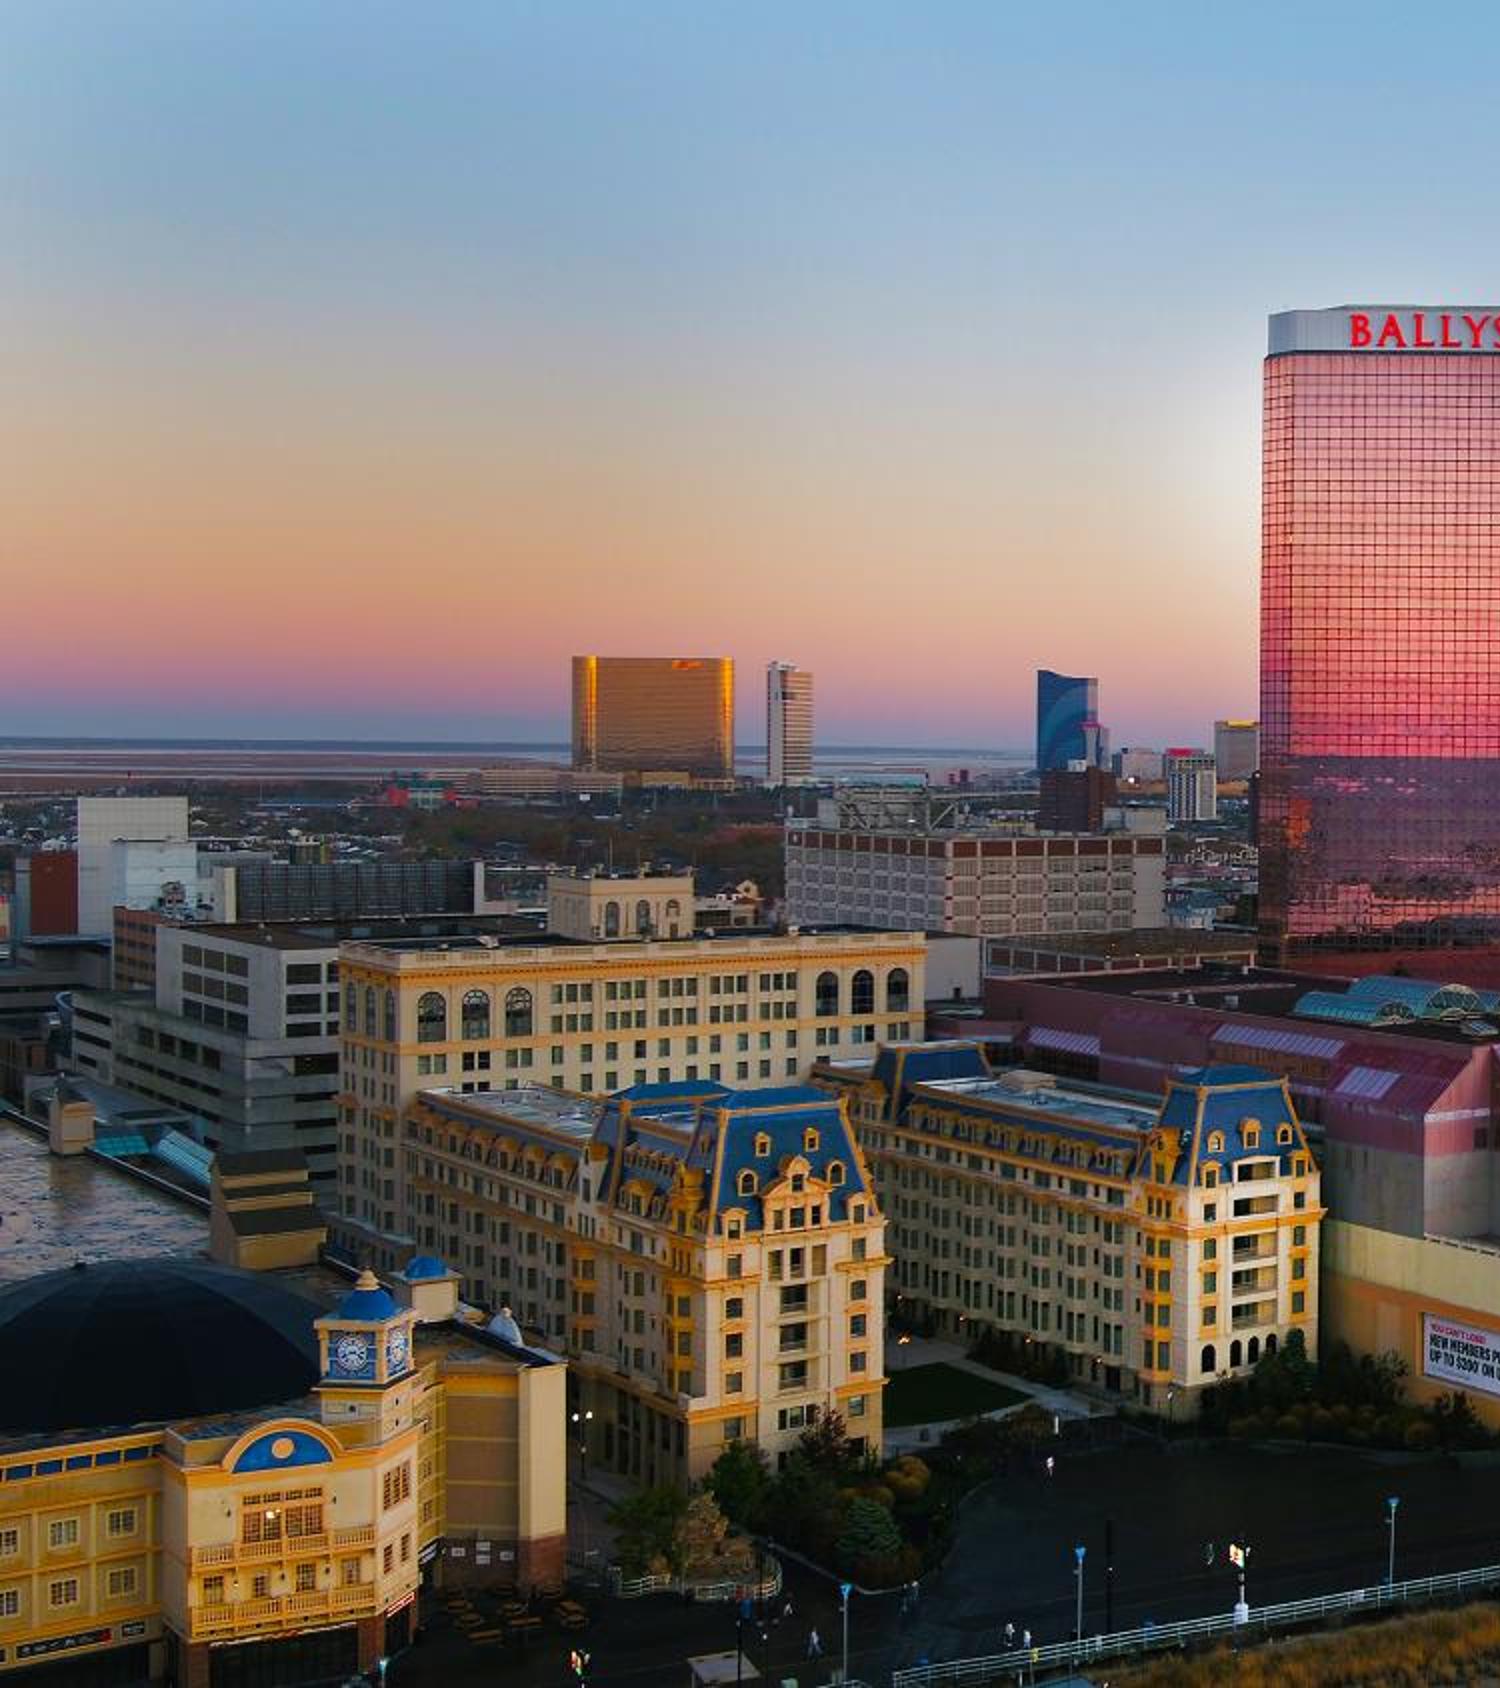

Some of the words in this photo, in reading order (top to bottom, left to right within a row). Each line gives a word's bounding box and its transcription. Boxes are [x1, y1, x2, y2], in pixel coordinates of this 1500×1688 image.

[1430, 1333, 1449, 1350] NEW
[1450, 1338, 1490, 1361] MEMBERS
[1430, 1348, 1442, 1363] UP
[1444, 1351, 1455, 1367] TO
[1482, 1363, 1495, 1379] ON
